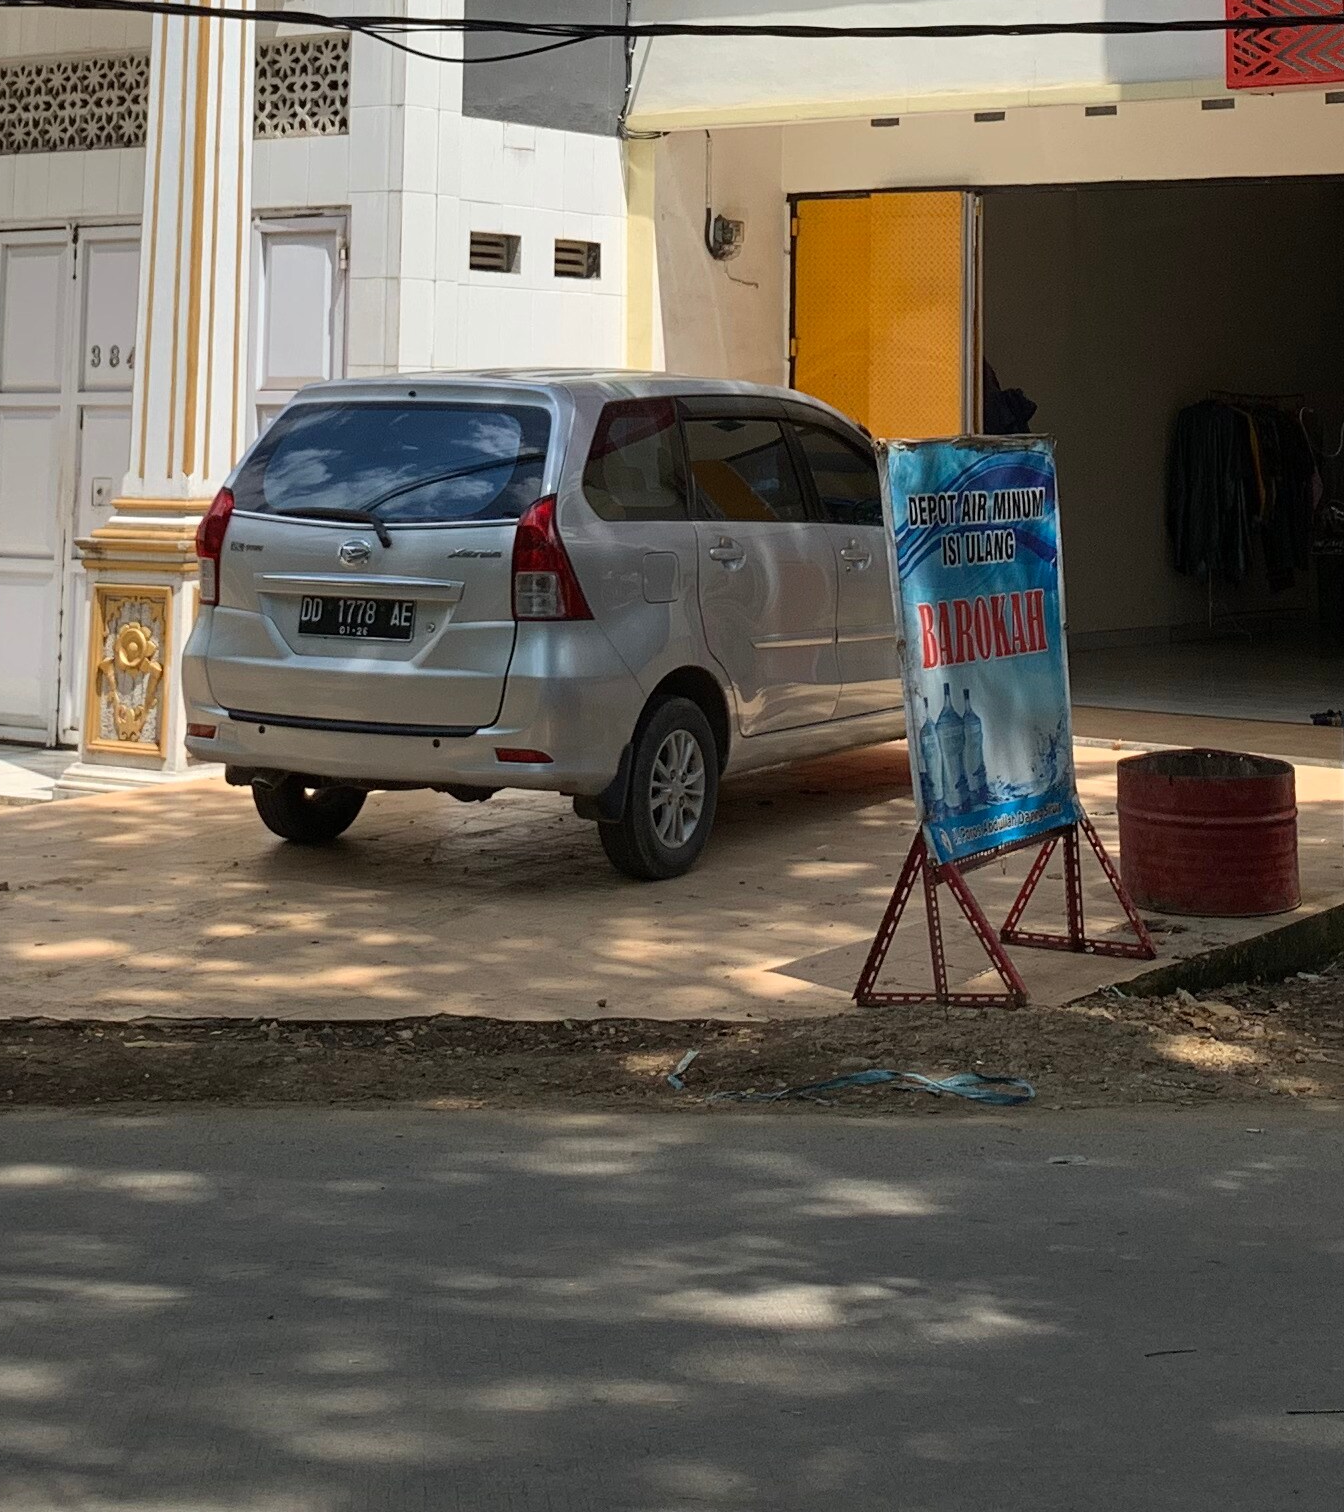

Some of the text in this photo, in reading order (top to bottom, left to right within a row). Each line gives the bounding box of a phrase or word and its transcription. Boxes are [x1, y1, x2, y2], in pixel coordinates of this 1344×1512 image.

[908, 488, 1045, 526] DEPOT AIR MINUM
[942, 530, 1016, 566] ISI ULANG
[301, 596, 413, 627] DD 1778 AE
[918, 589, 1048, 670] BAROKAH
